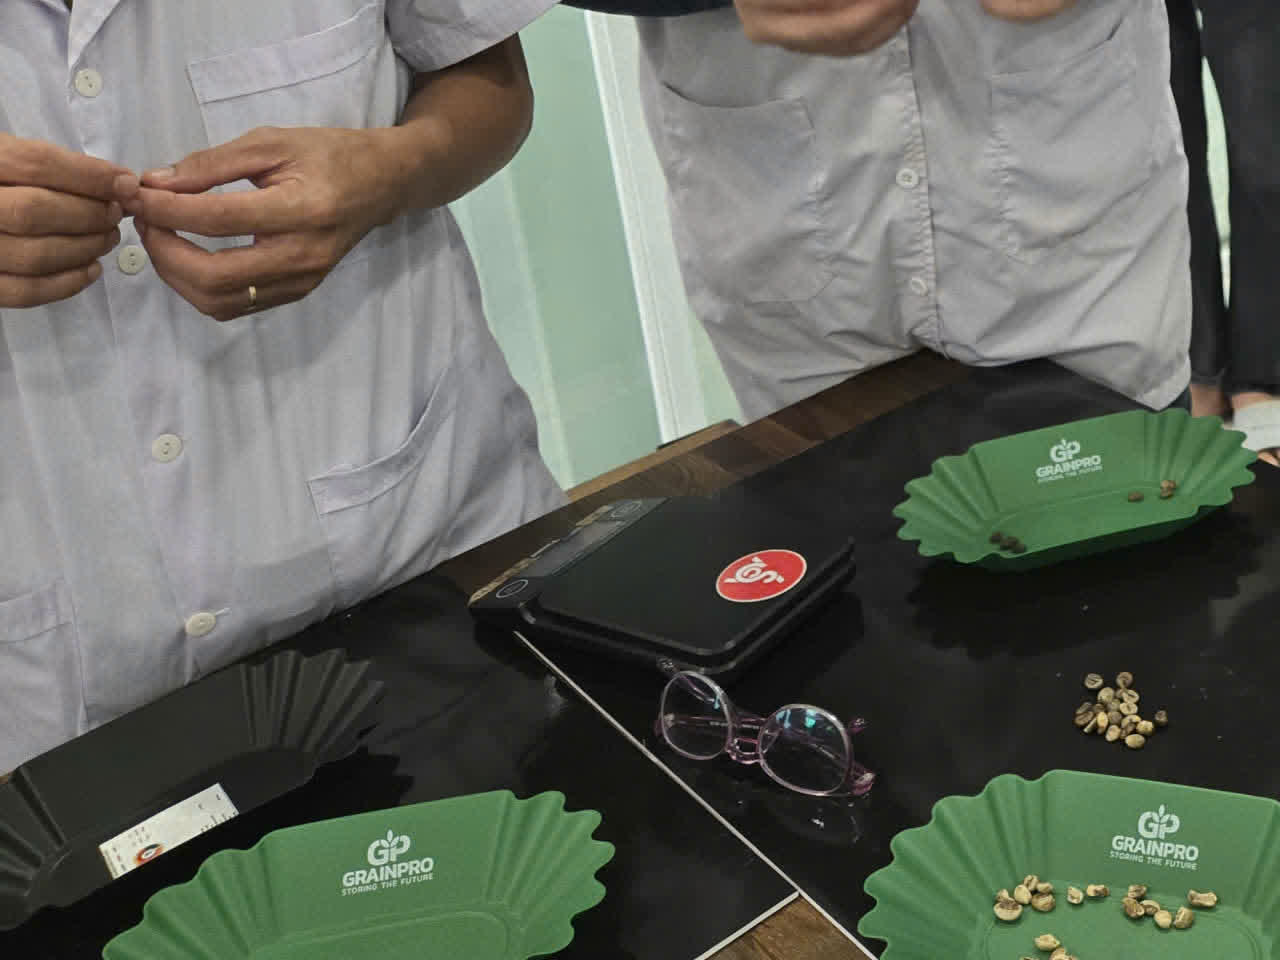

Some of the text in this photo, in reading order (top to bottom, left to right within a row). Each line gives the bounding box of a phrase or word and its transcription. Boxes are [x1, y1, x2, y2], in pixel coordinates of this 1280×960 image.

[1035, 455, 1101, 478] GRAINPRO
[1111, 835, 1199, 862] GRAINPRO
[342, 857, 434, 887] GRAINPRO
[1165, 860, 1198, 871] FUTURE
[341, 872, 434, 897] STORING THE FUTURE
